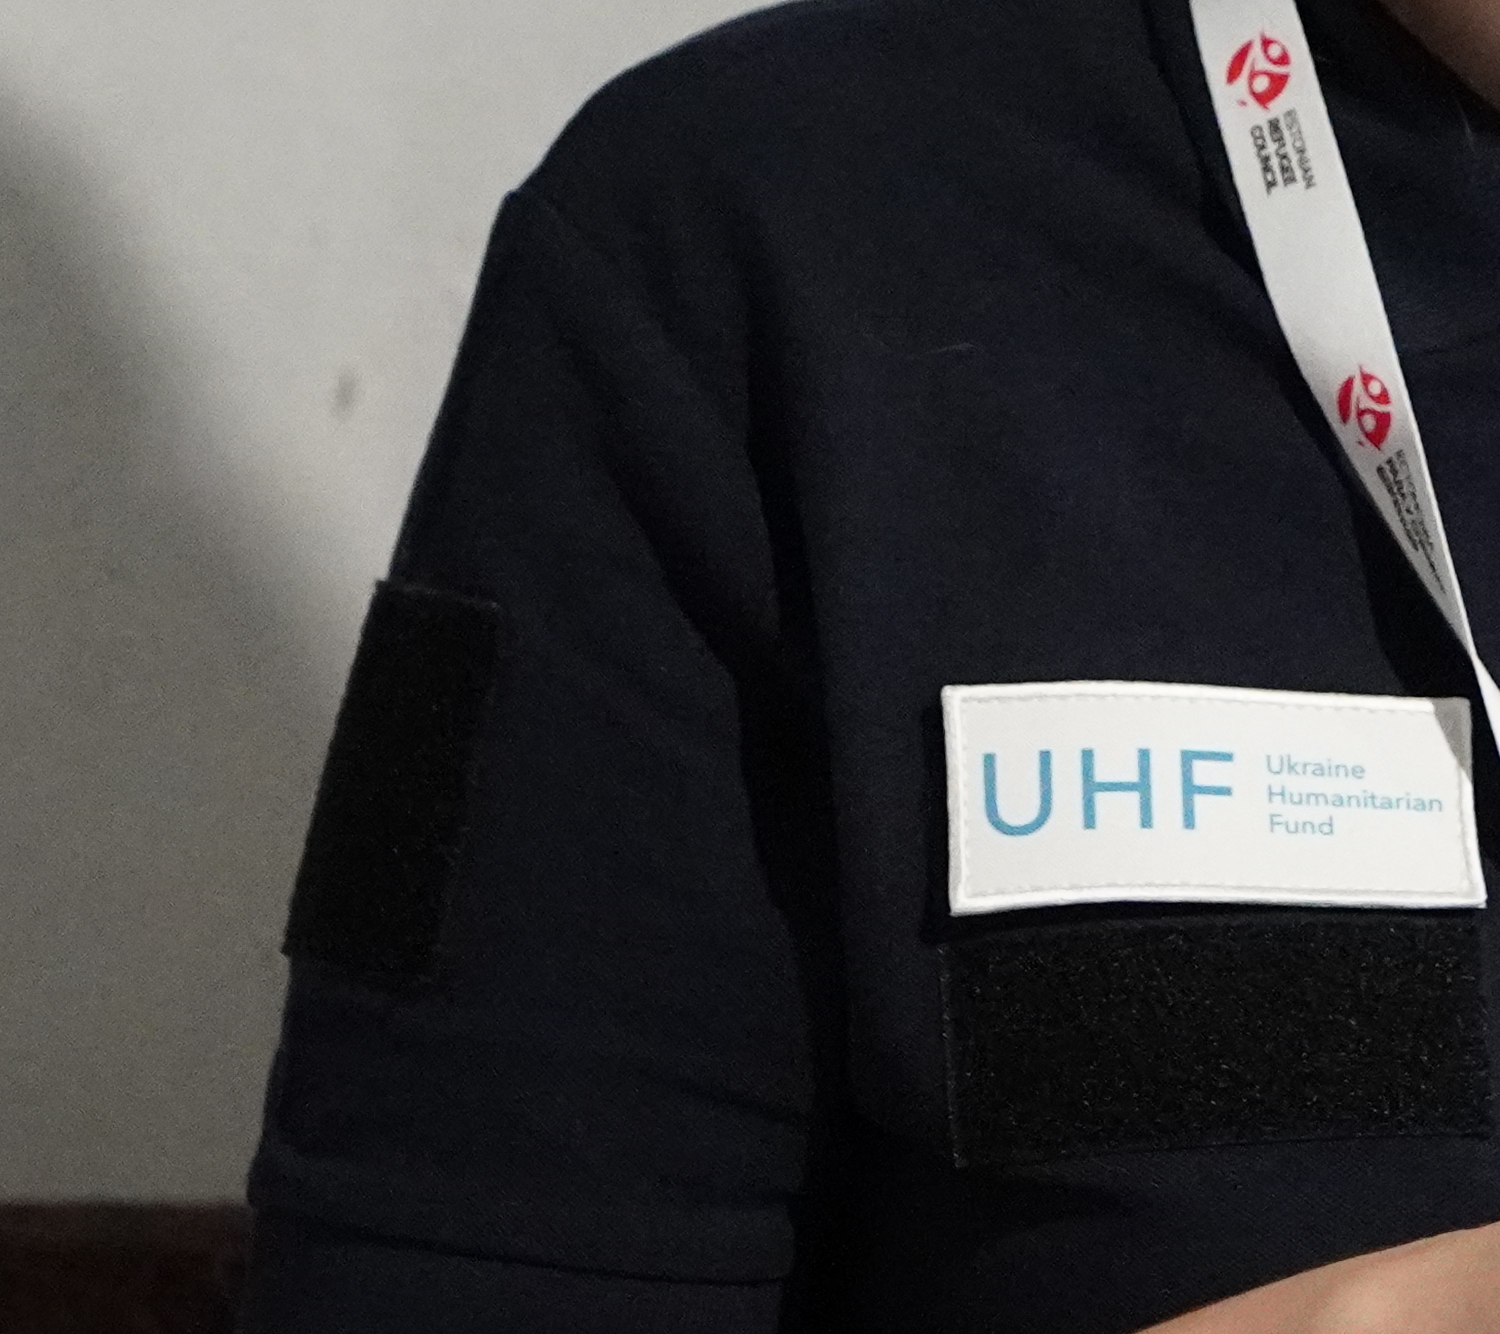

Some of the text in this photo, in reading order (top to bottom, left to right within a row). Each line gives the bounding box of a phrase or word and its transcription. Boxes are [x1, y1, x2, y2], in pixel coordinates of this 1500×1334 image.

[1265, 754, 1367, 782] Ukraine
[982, 747, 1234, 837] UHF
[1266, 785, 1444, 814] Humanitarian
[1268, 814, 1335, 838] Fund
